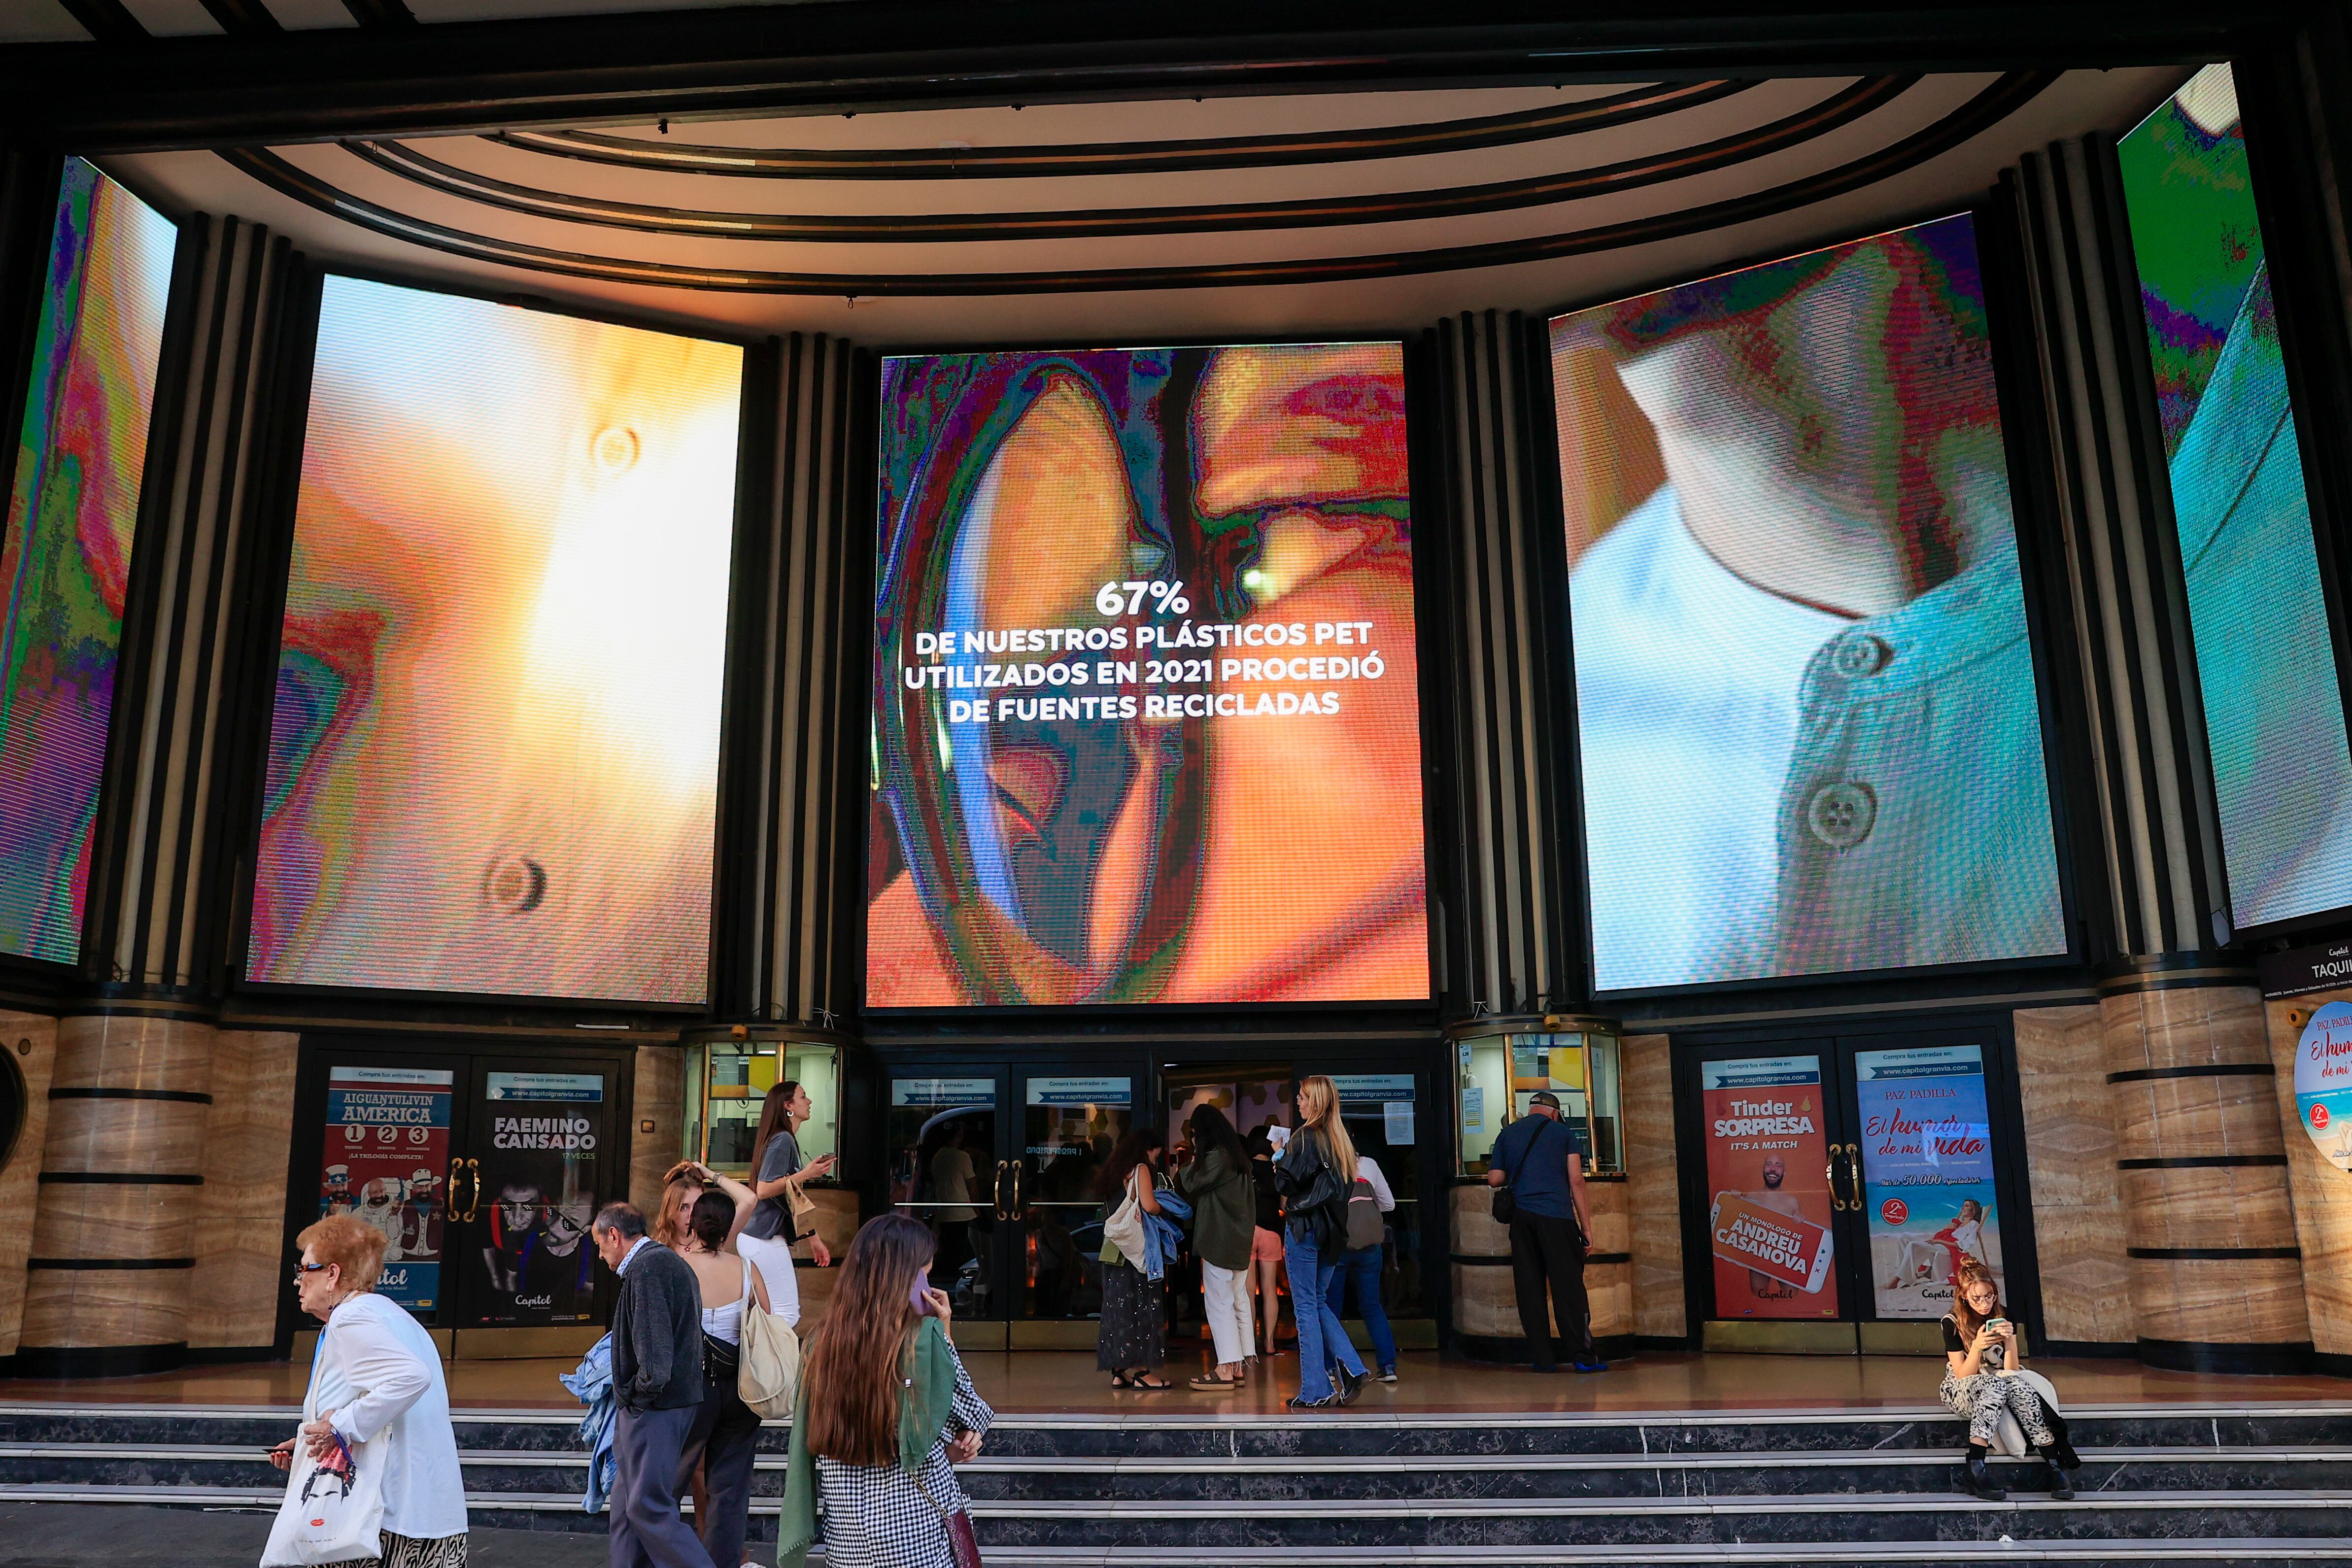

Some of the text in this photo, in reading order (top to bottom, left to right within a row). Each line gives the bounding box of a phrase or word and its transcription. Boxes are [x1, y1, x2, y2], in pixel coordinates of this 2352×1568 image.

[1095, 580, 1190, 616] 67%
[915, 619, 1373, 654] DE NUESTROS PLÁSTICOS PET
[904, 649, 1385, 690] UTILIZADOS EN 2021 PROCEDIÓ
[949, 691, 1340, 723] DE FUENTES RECICLADAS
[2328, 946, 2349, 956] Capitol
[2317, 1020, 2330, 1031] PAZ
[2311, 1040, 2324, 1060] El
[1882, 1065, 1968, 1075] www.capitolgranvia.com
[2322, 1059, 2350, 1078] de mi
[1727, 1075, 1807, 1084] www.capitolgranvia.com
[343, 1093, 434, 1106] AIGUANTULIVIN
[1885, 1088, 1956, 1100] PAZ PADILLA
[341, 1102, 432, 1124] AMÉRICA
[1730, 1099, 1793, 1117] Tinder
[494, 1117, 590, 1134] FAEMINO
[1714, 1116, 1815, 1137] SORPRESA
[1866, 1107, 1963, 1136] El humor
[350, 1125, 424, 1142] 1 2 3
[493, 1133, 596, 1150] CANSADO
[1762, 1141, 1798, 1150] MATCH
[1878, 1137, 1898, 1155] de
[1901, 1140, 1923, 1154] mi
[1902, 1174, 1943, 1186] 50.000
[1738, 1212, 1750, 1221] UN
[1750, 1217, 1791, 1236] MONÓLOGO
[1730, 1219, 1801, 1255] ANDREU
[1716, 1228, 1807, 1275] CASANOVA
[376, 1268, 409, 1285] itol
[515, 1295, 551, 1307] Capitol
[1758, 1289, 1793, 1301] Capitol
